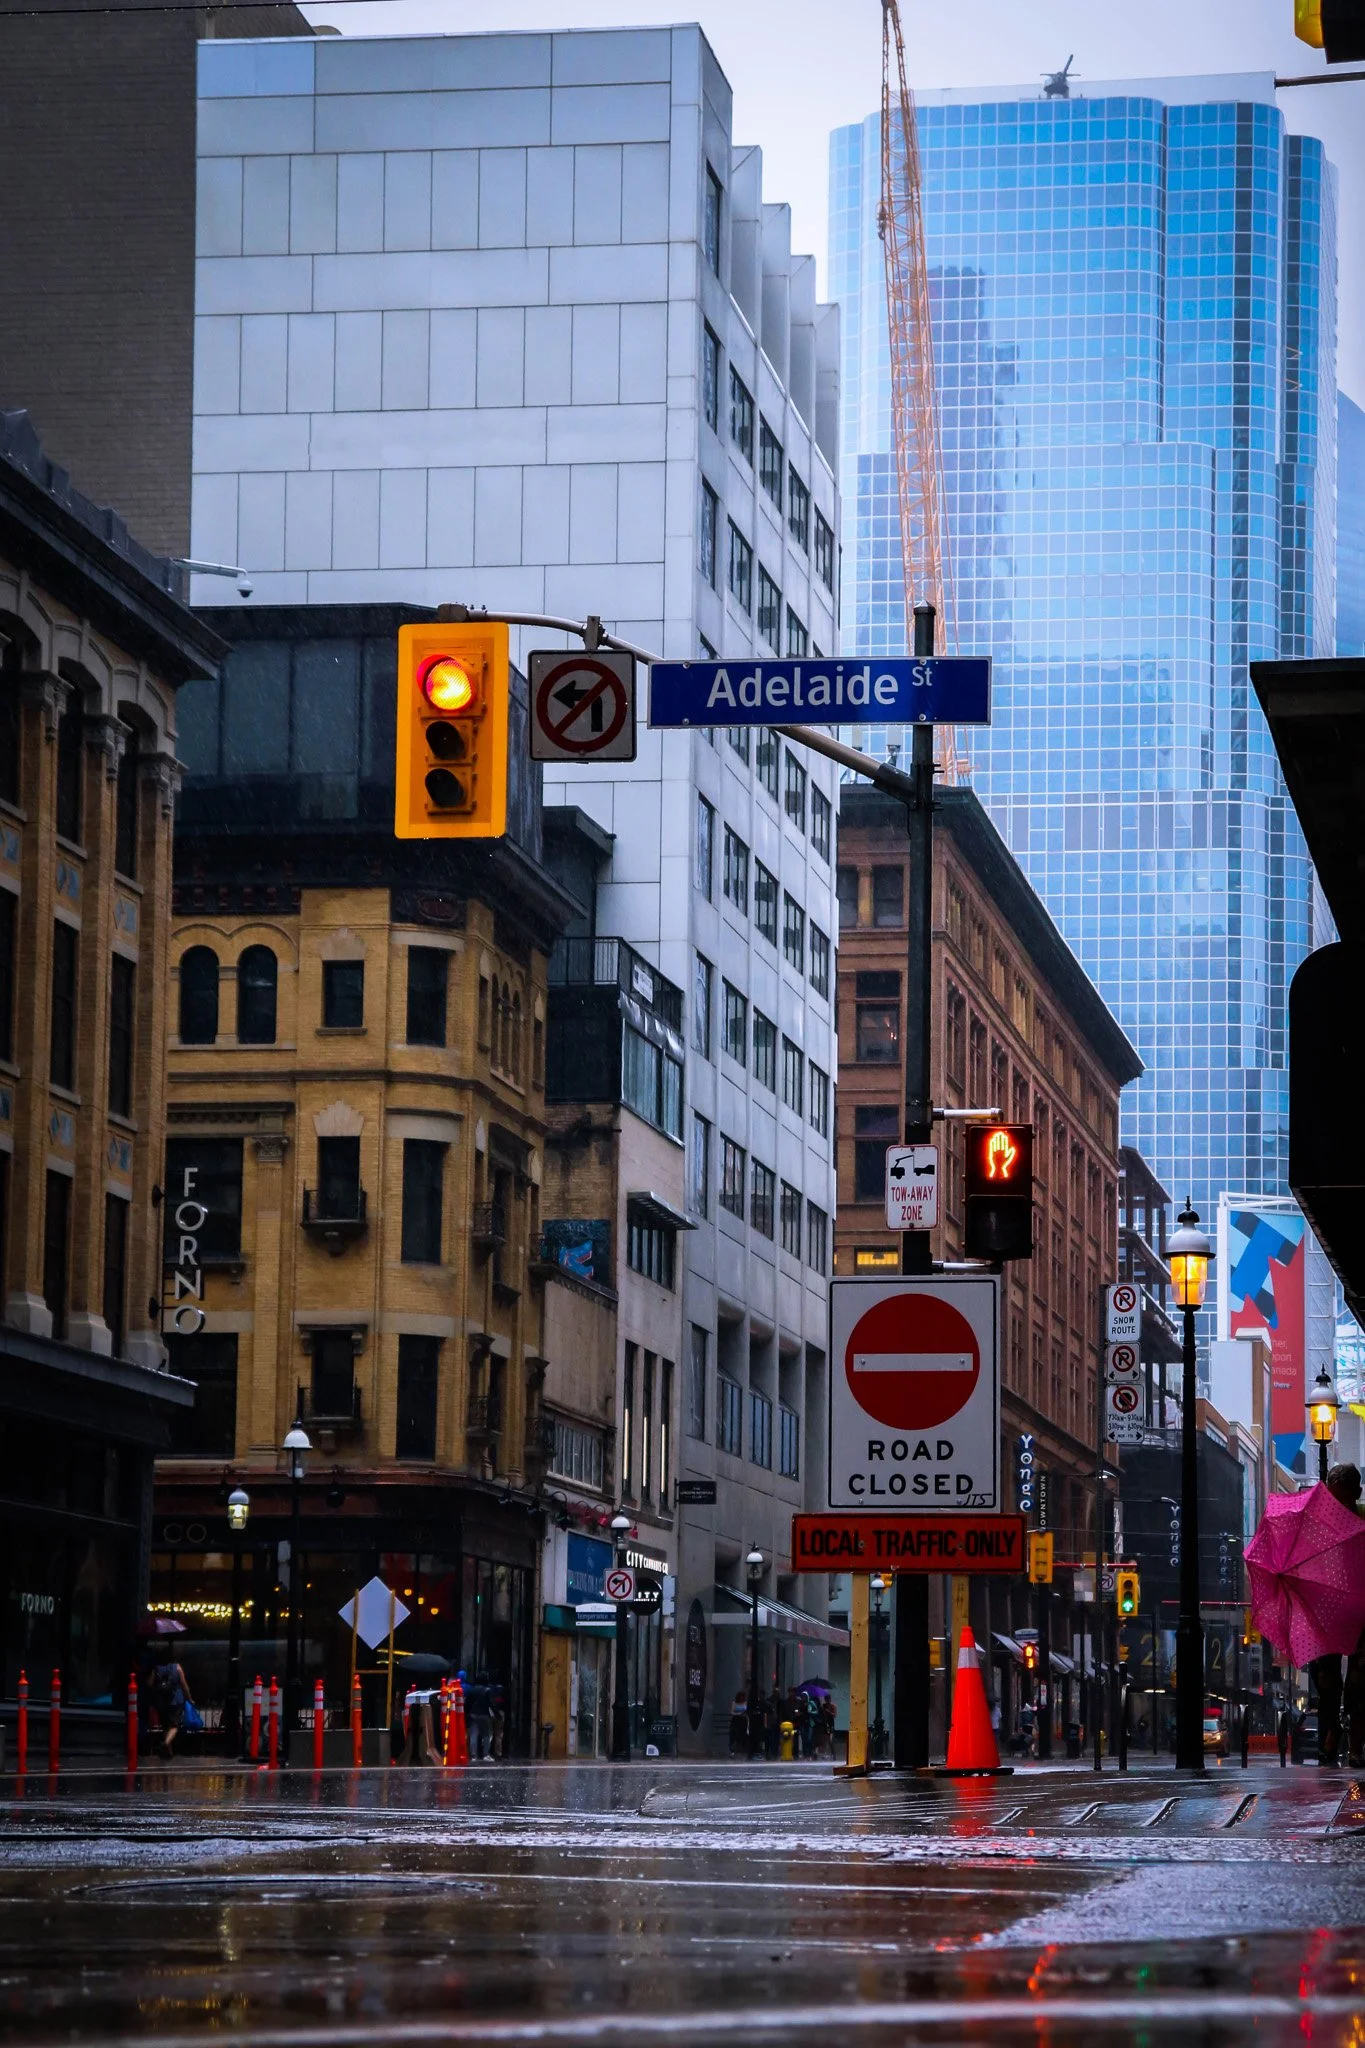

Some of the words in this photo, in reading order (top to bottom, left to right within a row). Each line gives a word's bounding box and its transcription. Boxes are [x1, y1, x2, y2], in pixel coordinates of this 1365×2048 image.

[706, 665, 899, 708] Adelaide
[911, 665, 933, 688] St
[891, 1186, 934, 1202] TOW-AWAY
[901, 1205, 923, 1221] ZONE
[174, 1166, 207, 1335] FORNO
[1111, 1325, 1136, 1335] ROUTE
[1113, 1316, 1135, 1325] SNOW
[867, 1439, 954, 1461] ROAD
[848, 1473, 973, 1496] CLOSED
[1020, 1434, 1033, 1512] Yonge
[799, 1528, 864, 1557] LOCAL
[872, 1528, 957, 1557] TRAFFIC
[964, 1529, 1018, 1557] ONLY
[1169, 1505, 1180, 1567] Yonge
[626, 1550, 644, 1569] CITY
[21, 1592, 55, 1615] FORNO
[638, 1591, 659, 1599] ITY
[1211, 1637, 1222, 1670] 2
